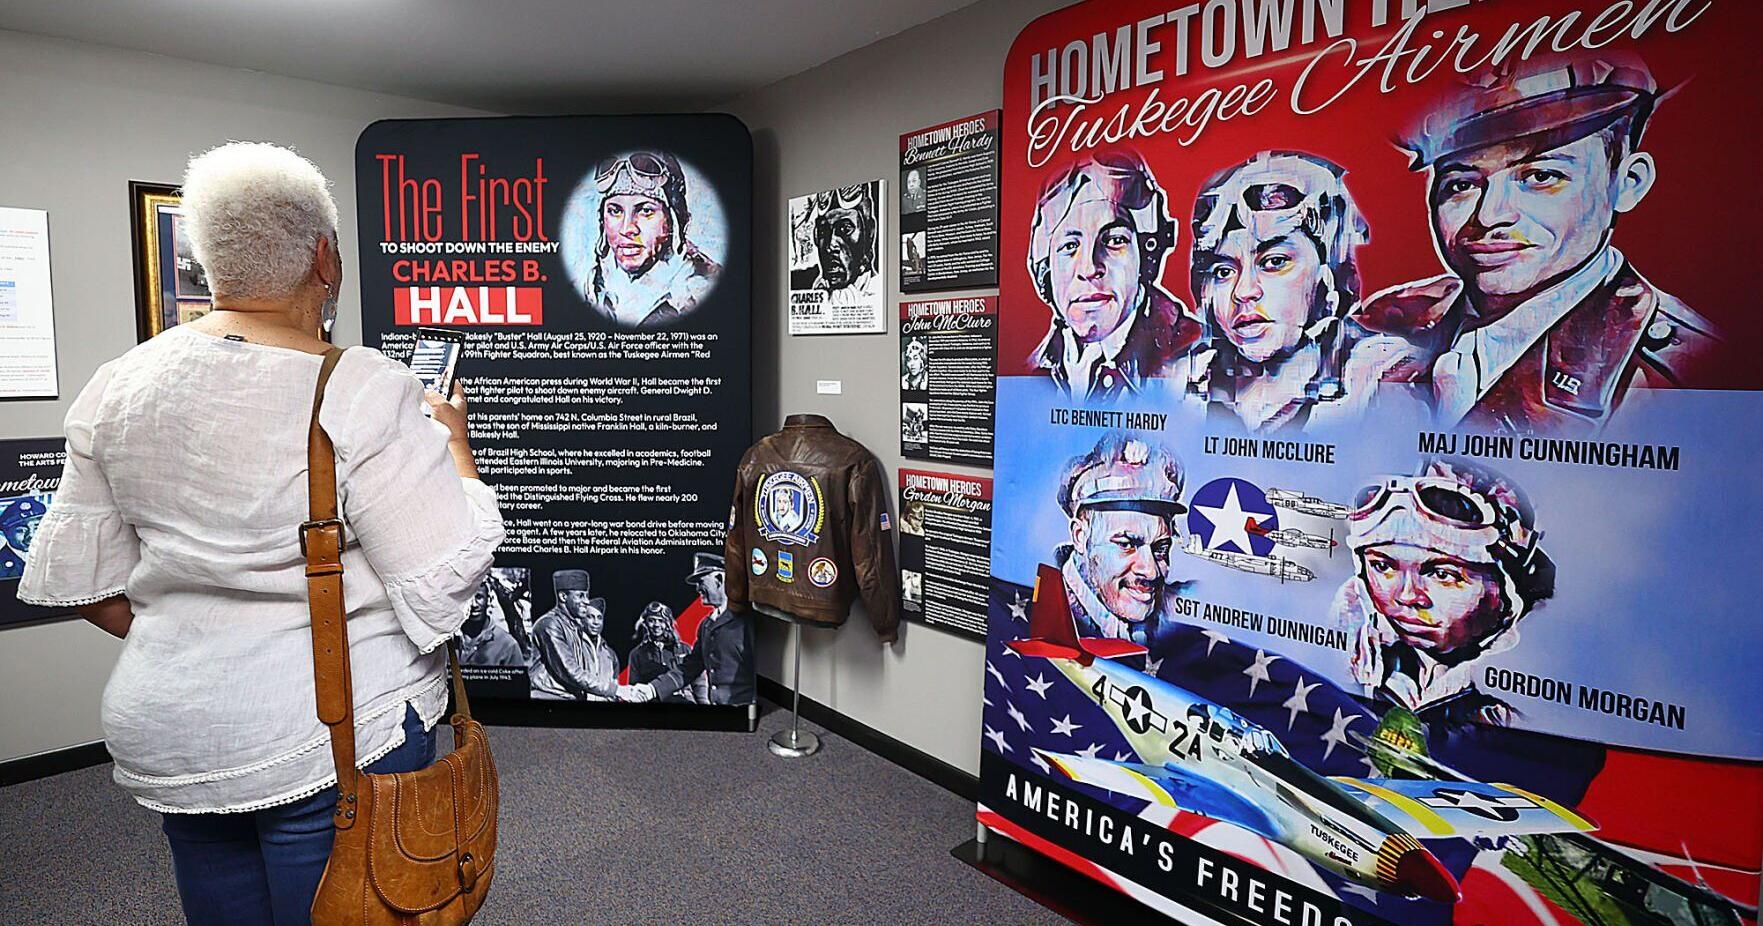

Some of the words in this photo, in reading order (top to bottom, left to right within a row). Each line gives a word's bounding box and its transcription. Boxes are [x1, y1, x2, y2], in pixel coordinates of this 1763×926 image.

[1031, 0, 1343, 114] HOMETOWN
[1027, 79, 1278, 168] Tuskegee
[1290, 0, 1713, 115] Airmen
[907, 127, 951, 149] HOMETOWN
[952, 118, 985, 138] HEROES
[903, 146, 947, 165] Bennett
[948, 135, 993, 154] Hardy
[375, 154, 443, 242] The
[461, 153, 548, 242] First
[380, 242, 398, 253] TO
[400, 242, 443, 253] SHOOT
[445, 242, 486, 253] DOWN
[488, 242, 513, 253] THE
[516, 242, 560, 253] ENEMY
[392, 260, 517, 282] CHARLES
[523, 260, 548, 282] B.
[410, 286, 532, 323] HALL
[791, 292, 824, 304] CHARLES
[908, 302, 952, 317] HOMETOWN
[953, 299, 985, 313] HEROES
[902, 313, 931, 333] John
[933, 313, 992, 331] McClure
[464, 350, 482, 358] 99th
[483, 350, 511, 359] Fighter
[571, 350, 596, 358] known
[623, 351, 659, 360] Tuskegee
[476, 342, 493, 350] pilot
[528, 342, 549, 351] Army
[480, 386, 505, 395] fighter
[506, 386, 523, 395] pilot
[534, 386, 555, 394] shoot
[673, 387, 701, 395] Dwight
[541, 379, 561, 387] press
[563, 378, 588, 387] during
[705, 378, 721, 386] first
[499, 395, 553, 404] congratulated
[555, 413, 569, 421] 742
[1050, 409, 1069, 425] LTC
[1071, 410, 1123, 428] BENNETT
[1126, 412, 1167, 431] HARDY
[470, 431, 500, 440] Blakesly
[531, 422, 570, 431] Mississippi
[594, 449, 625, 457] excelled
[1204, 436, 1219, 454] LT
[1222, 438, 1257, 457] JOHN
[1262, 440, 1335, 464] MCCLURE
[1418, 431, 1457, 454] MAJ
[1461, 434, 1513, 459] JOHN
[1520, 438, 1680, 470] CUNNINGHAM
[490, 466, 537, 475] participated
[509, 458, 538, 466] Eastern
[540, 458, 563, 466] Illinois
[605, 459, 640, 467] majoring
[0, 473, 60, 492] metow
[519, 484, 557, 493] promoted
[568, 485, 591, 494] major
[906, 474, 949, 492] HOMETOWN
[949, 480, 982, 496] HEROES
[524, 493, 574, 502] Distinguished
[575, 493, 598, 502] Flying
[655, 494, 680, 502] nearly
[903, 486, 942, 503] Gordon
[943, 492, 991, 512] Morgan
[647, 520, 666, 528] drive
[695, 521, 724, 530] moving
[533, 545, 562, 553] Charles
[589, 546, 618, 555] Airpark
[591, 537, 620, 545] Federal
[1175, 597, 1200, 618] SGT
[1203, 604, 1264, 633] ANDREW
[1267, 617, 1348, 651] DUNNIGAN
[1092, 675, 1107, 706] 4
[1484, 666, 1572, 705] GORDON
[1578, 685, 1686, 730] MORGAN
[1006, 773, 1175, 872] AMERICA'S
[1310, 824, 1359, 862] TUSKEGEE
